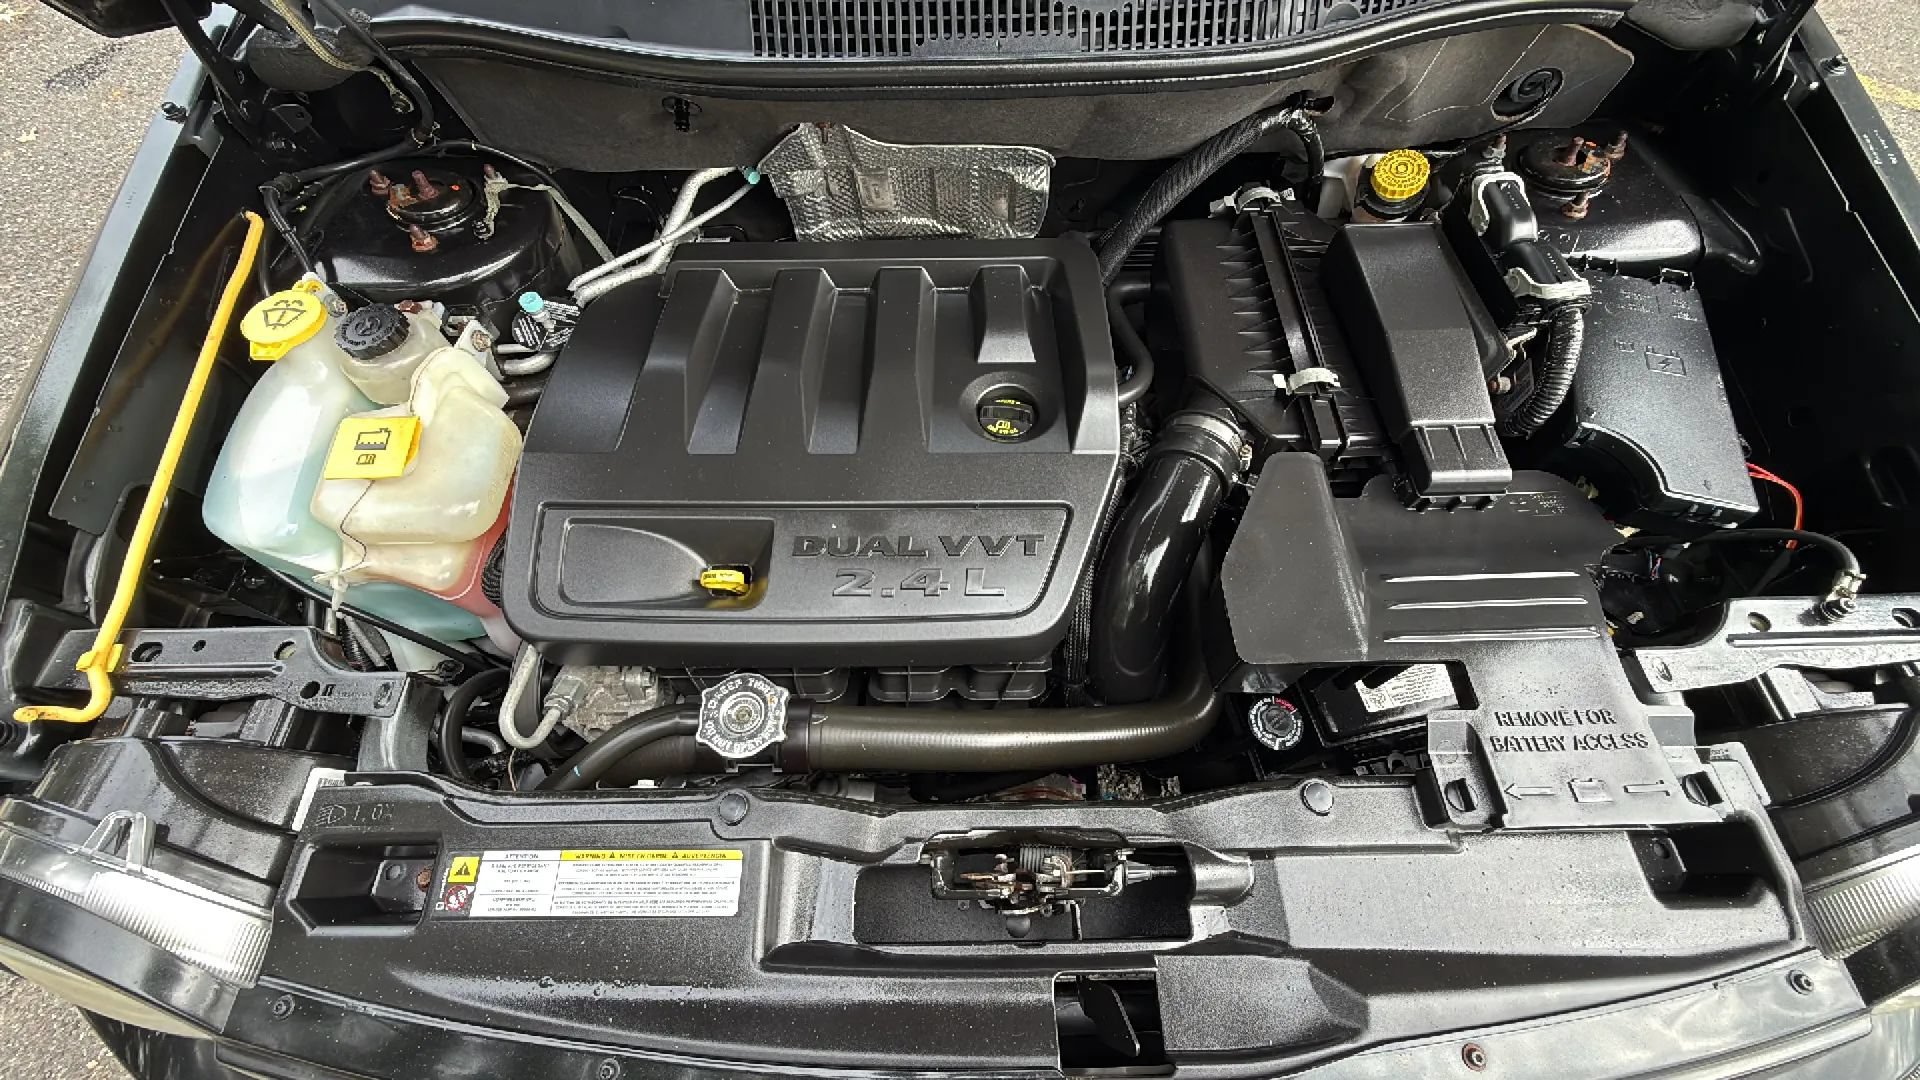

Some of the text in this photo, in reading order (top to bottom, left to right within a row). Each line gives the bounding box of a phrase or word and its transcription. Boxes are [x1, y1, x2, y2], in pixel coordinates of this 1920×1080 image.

[792, 535, 1046, 557] DUAL VVT
[714, 678, 743, 699] KEEP
[1494, 708, 1617, 726] REMOVE FOR
[1489, 732, 1650, 752] BATTERY ACCESS
